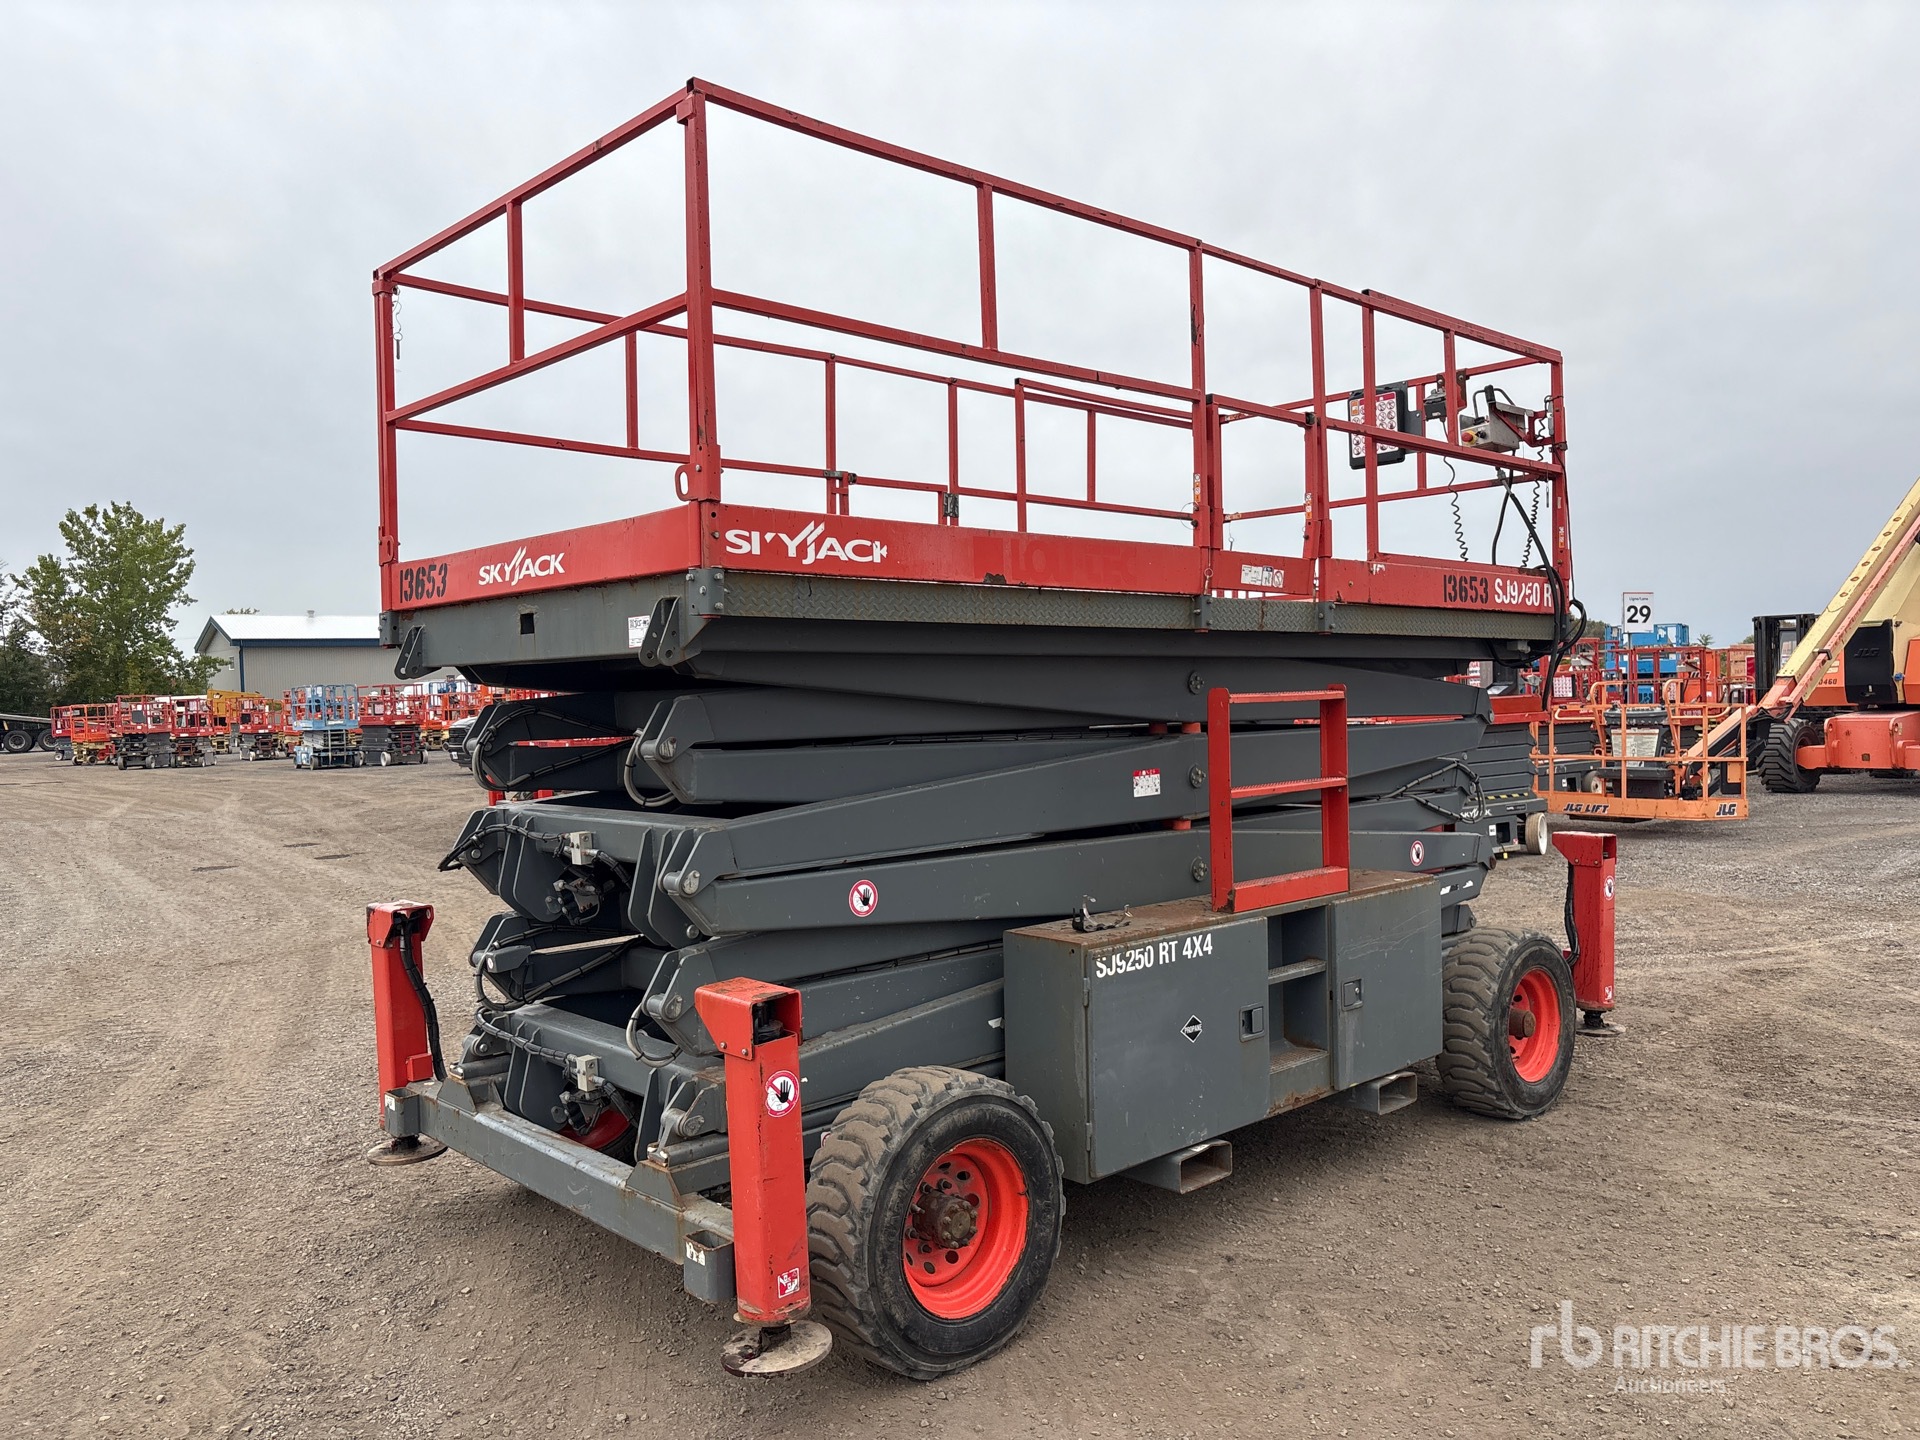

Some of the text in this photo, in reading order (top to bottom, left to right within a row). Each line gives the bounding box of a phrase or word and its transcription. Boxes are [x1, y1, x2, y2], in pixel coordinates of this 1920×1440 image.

[478, 546, 565, 586] SKYJACK
[399, 562, 448, 604] 13653
[1443, 574, 1489, 605] 13653
[1626, 604, 1652, 624] 29
[1853, 647, 1881, 658] JLG
[1563, 803, 1610, 814] JLG LIFT
[1715, 802, 1737, 817] JLG
[1159, 940, 1178, 966] RT
[1182, 933, 1213, 960] 4X4
[1184, 1023, 1202, 1034] PROPANE
